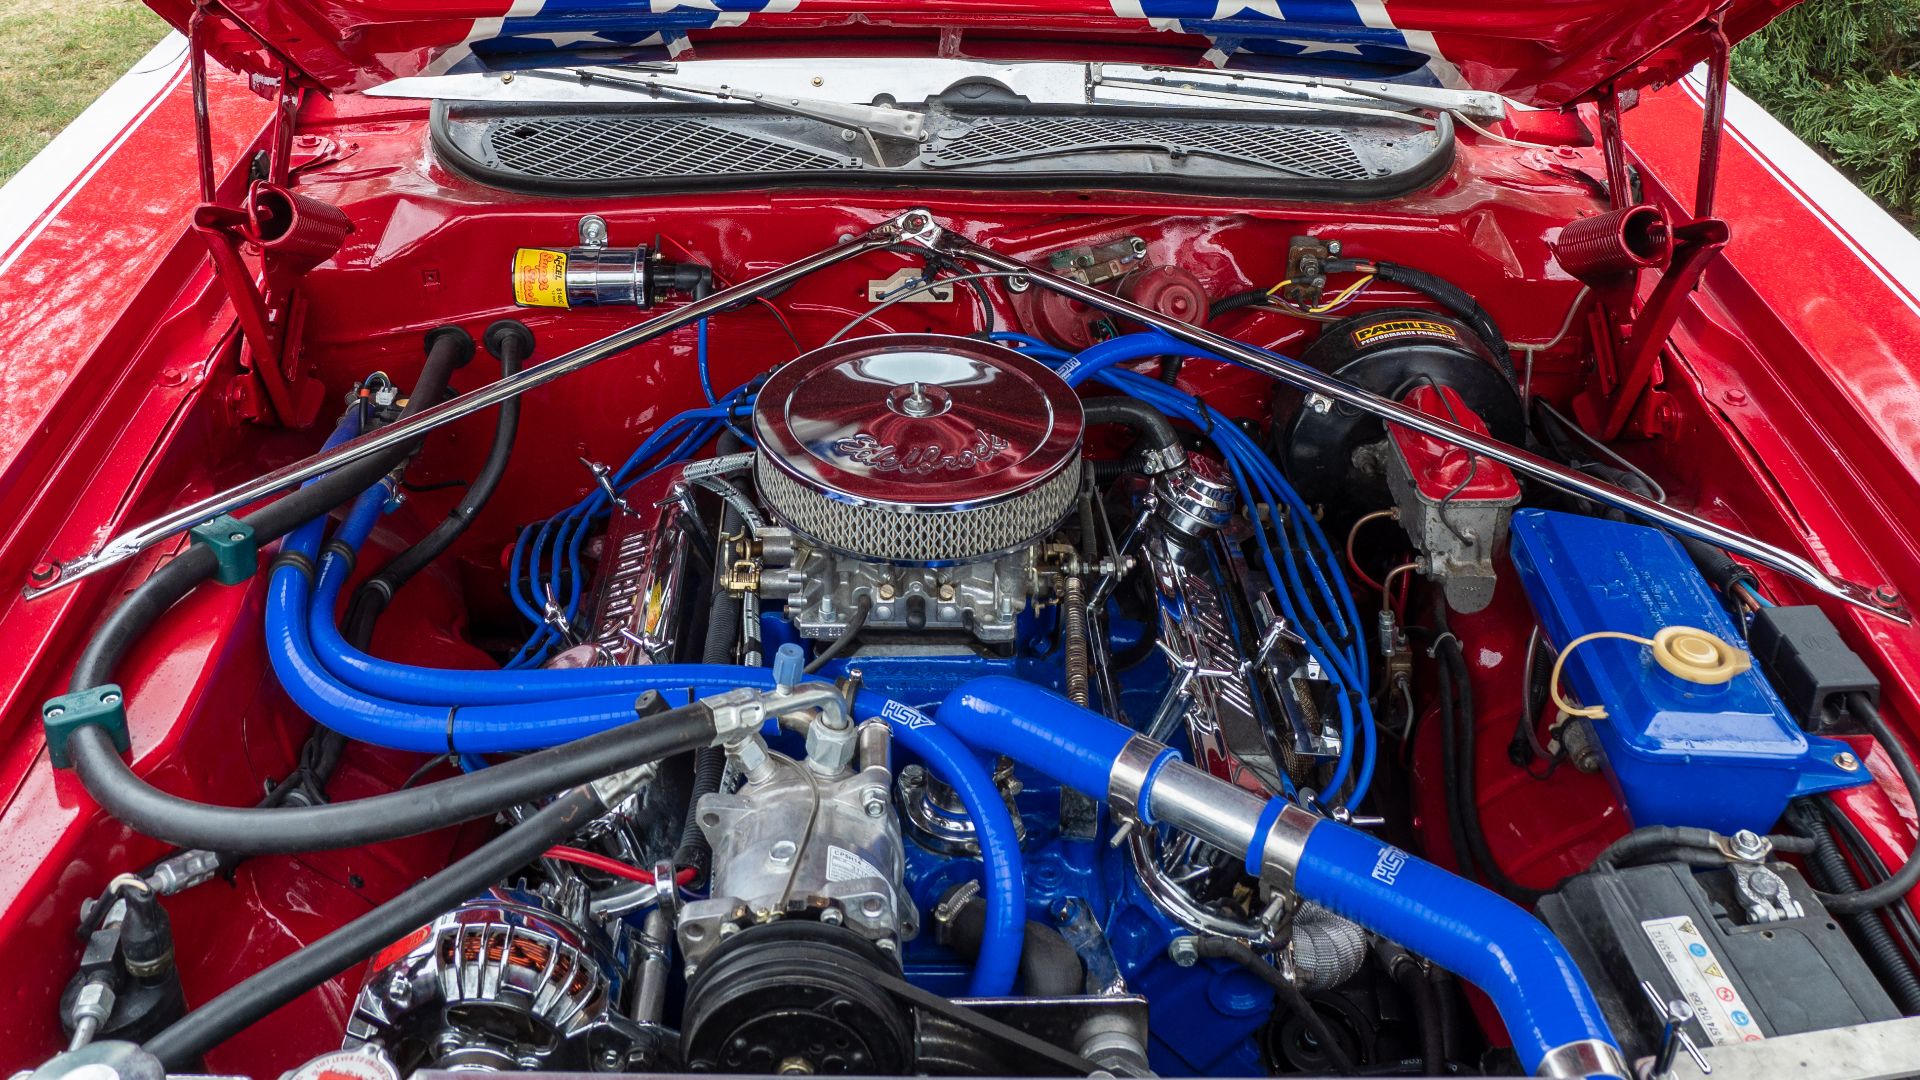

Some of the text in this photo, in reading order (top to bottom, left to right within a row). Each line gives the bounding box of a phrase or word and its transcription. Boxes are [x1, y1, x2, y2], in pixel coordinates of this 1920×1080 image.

[535, 251, 553, 291] Super
[553, 254, 565, 281] ACCEL
[1356, 321, 1456, 340] PAINLESS
[1360, 331, 1457, 346] PERFORMANCE PRODUCTS
[834, 428, 1009, 475] Edelbrock
